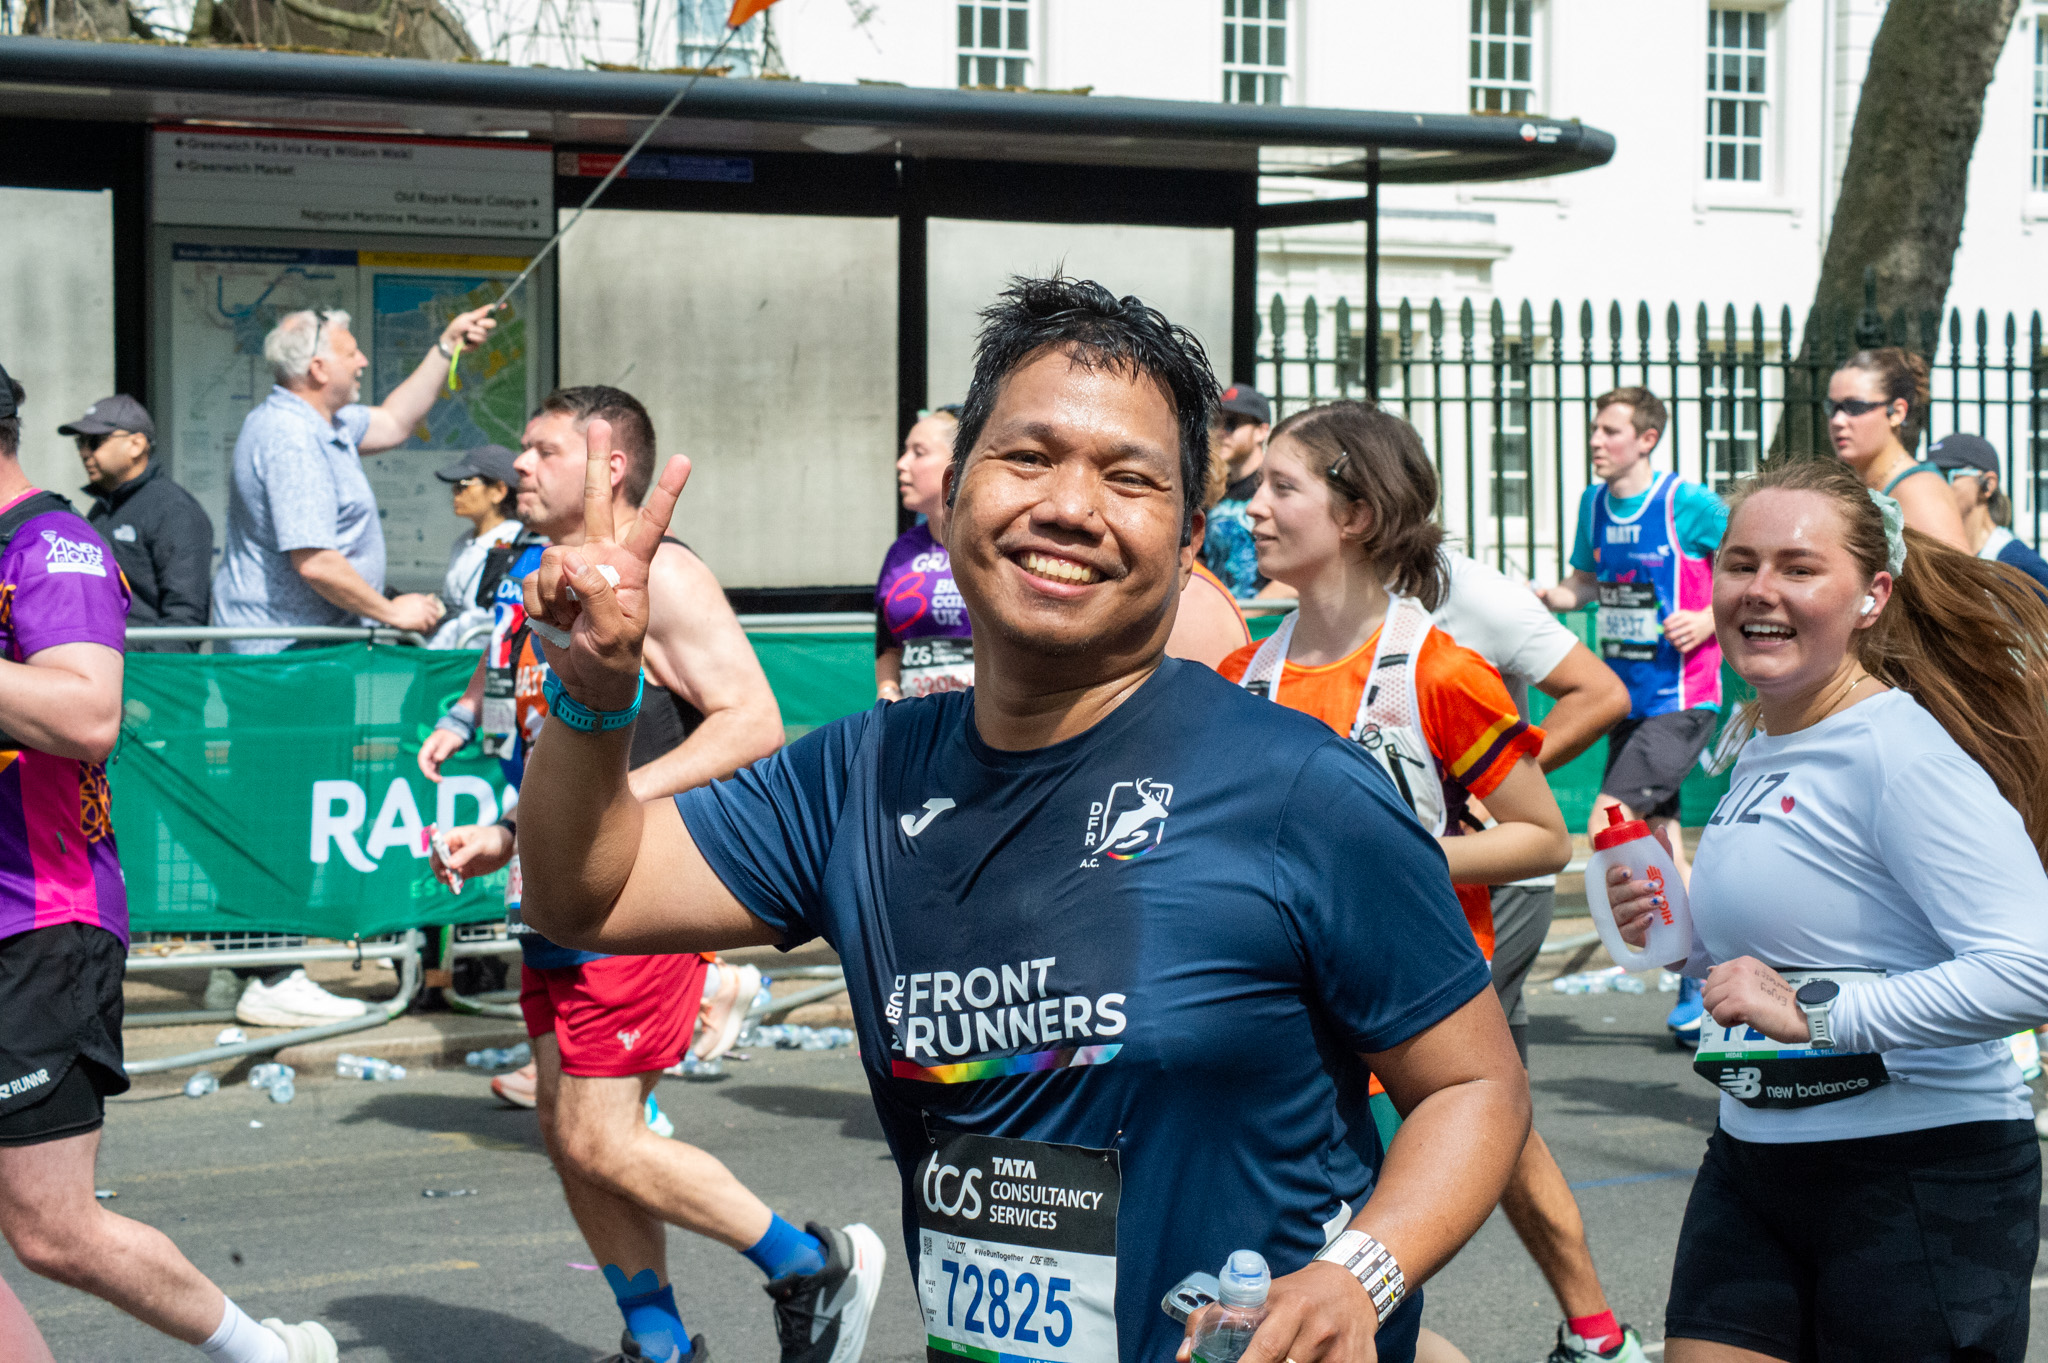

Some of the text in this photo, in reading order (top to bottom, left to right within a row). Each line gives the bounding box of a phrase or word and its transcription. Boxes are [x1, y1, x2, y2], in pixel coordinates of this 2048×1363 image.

[187, 137, 250, 152] Greenwich
[254, 141, 278, 153] Park
[306, 143, 330, 158] King
[187, 159, 294, 175] Greenwich Market
[394, 191, 528, 210] Old Royal Naval College
[301, 209, 350, 222] National
[353, 211, 403, 223] Maritime
[407, 213, 454, 225] Museum
[1709, 772, 1790, 826] LIZ
[310, 774, 520, 873] RAD
[1080, 857, 1100, 869] A.C.
[908, 956, 1056, 1014] FRONT
[905, 992, 1127, 1058] RUNNERS
[1724, 1051, 1744, 1059] MEDAL
[9, 1068, 51, 1095] RUNNR
[1766, 1075, 1870, 1100] new balance
[992, 1156, 1037, 1180] TATA
[923, 1149, 983, 1220] tcs
[990, 1180, 1104, 1211] CONSULTANCY
[989, 1204, 1058, 1231] SERVICES
[974, 1247, 1024, 1263] #WeRunTogether
[942, 1258, 1073, 1348] 72825
[951, 1341, 967, 1353] MEDAL
